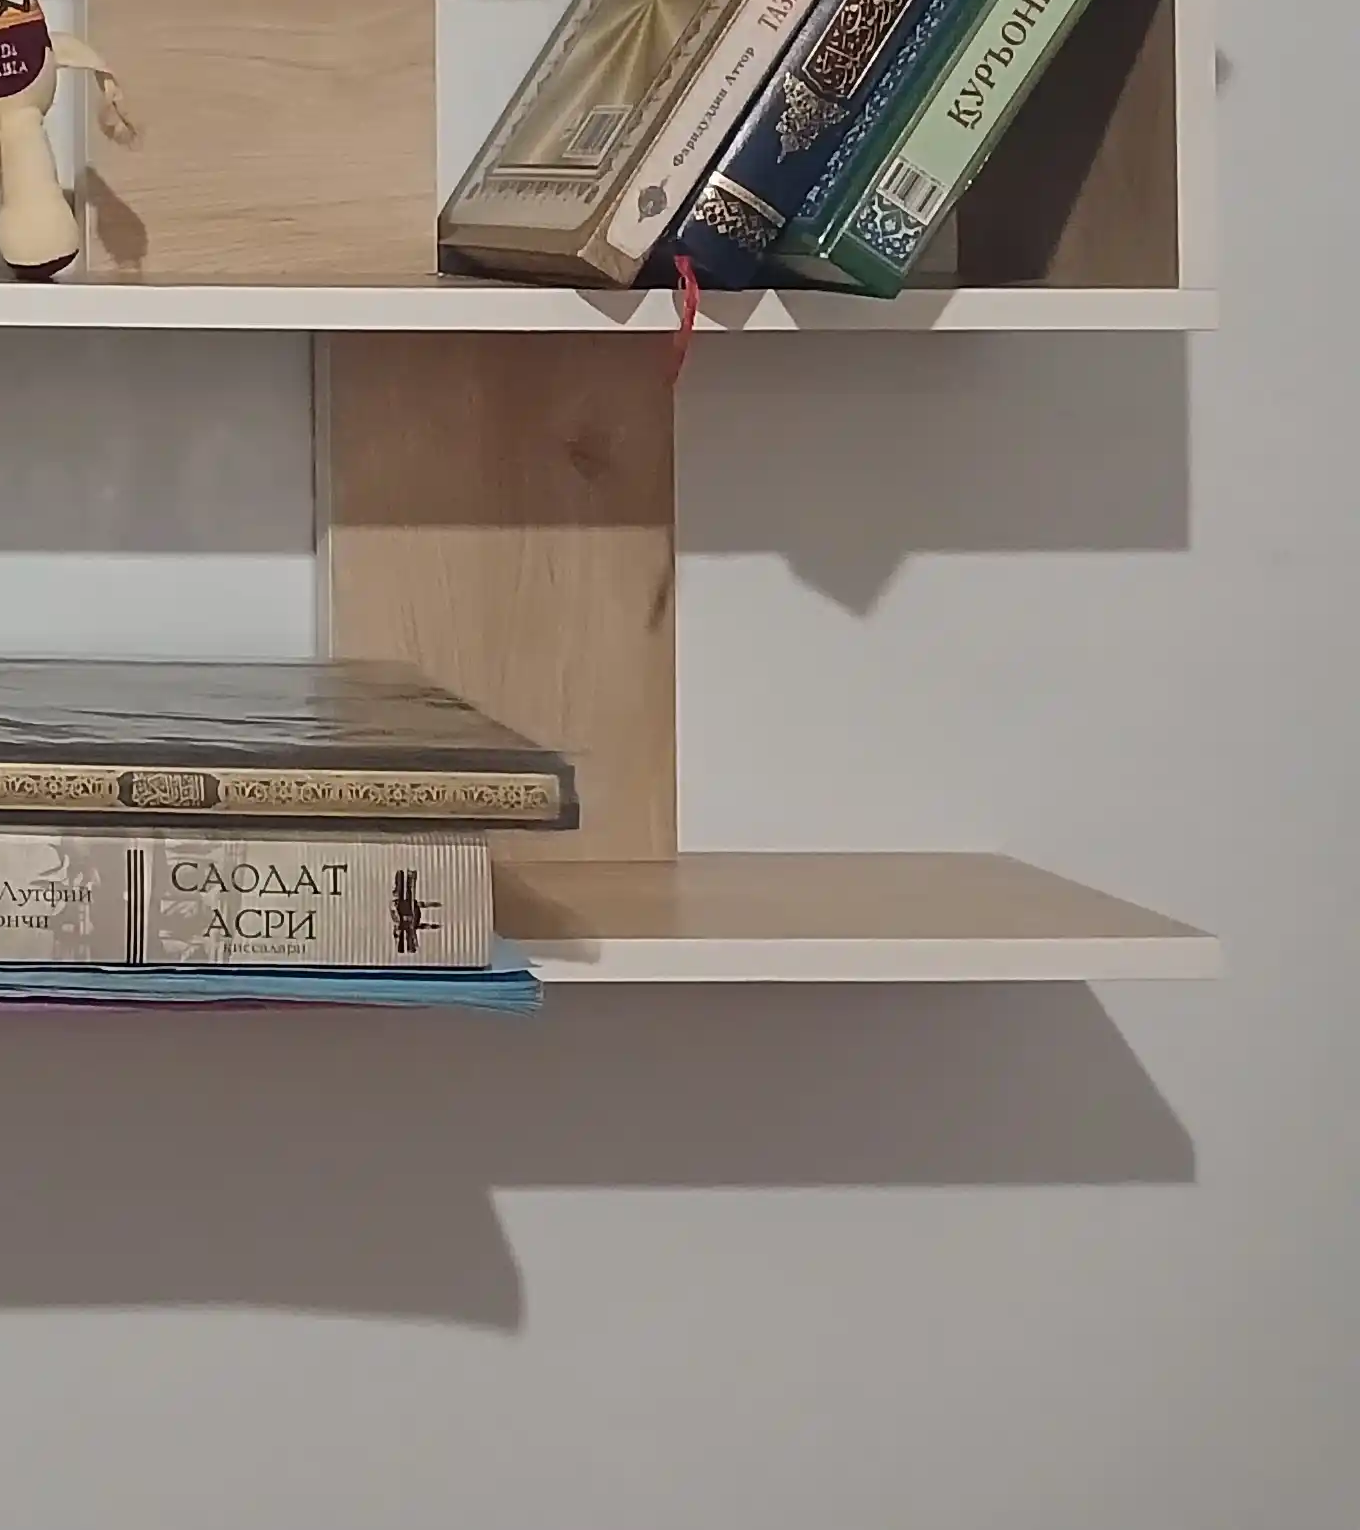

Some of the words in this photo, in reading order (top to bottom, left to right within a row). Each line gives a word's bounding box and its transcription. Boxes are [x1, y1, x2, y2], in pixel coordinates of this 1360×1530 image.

[672, 86, 729, 168] Фаридуддин
[725, 45, 755, 87] Аттор
[170, 862, 348, 898] САОДАТ
[202, 908, 318, 941] АСРИ
